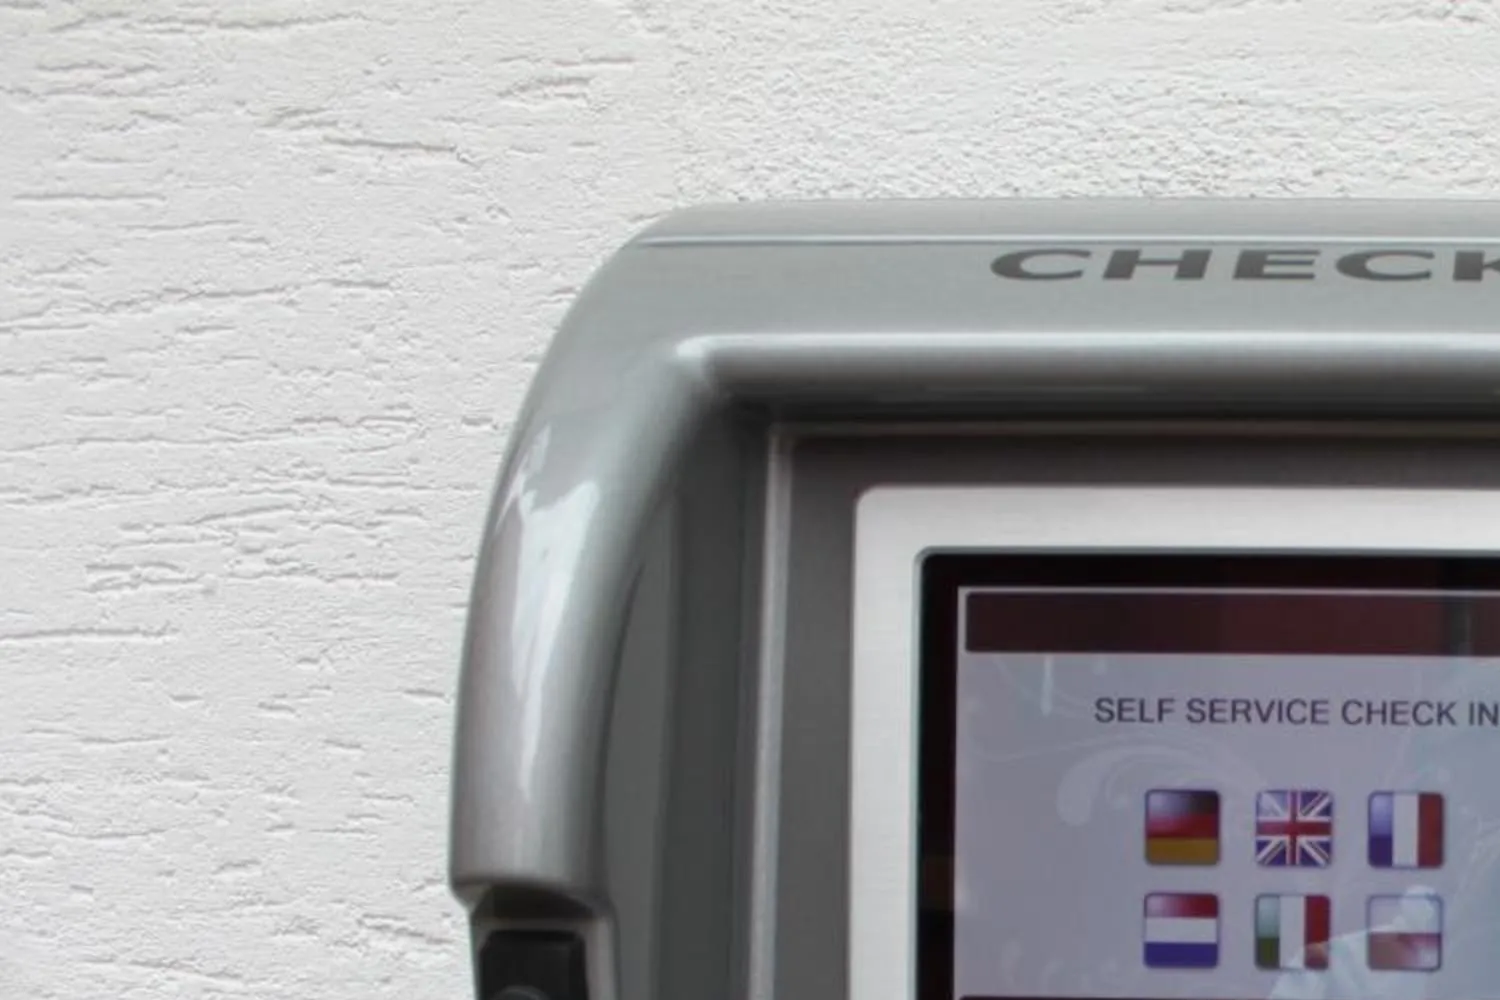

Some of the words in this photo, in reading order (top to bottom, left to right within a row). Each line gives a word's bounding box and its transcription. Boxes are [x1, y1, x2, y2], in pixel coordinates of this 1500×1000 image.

[1095, 698, 1174, 724] SELF
[1186, 699, 1330, 725] SERVICE
[1342, 700, 1456, 726] CHECK
[1468, 702, 1499, 727] IN
